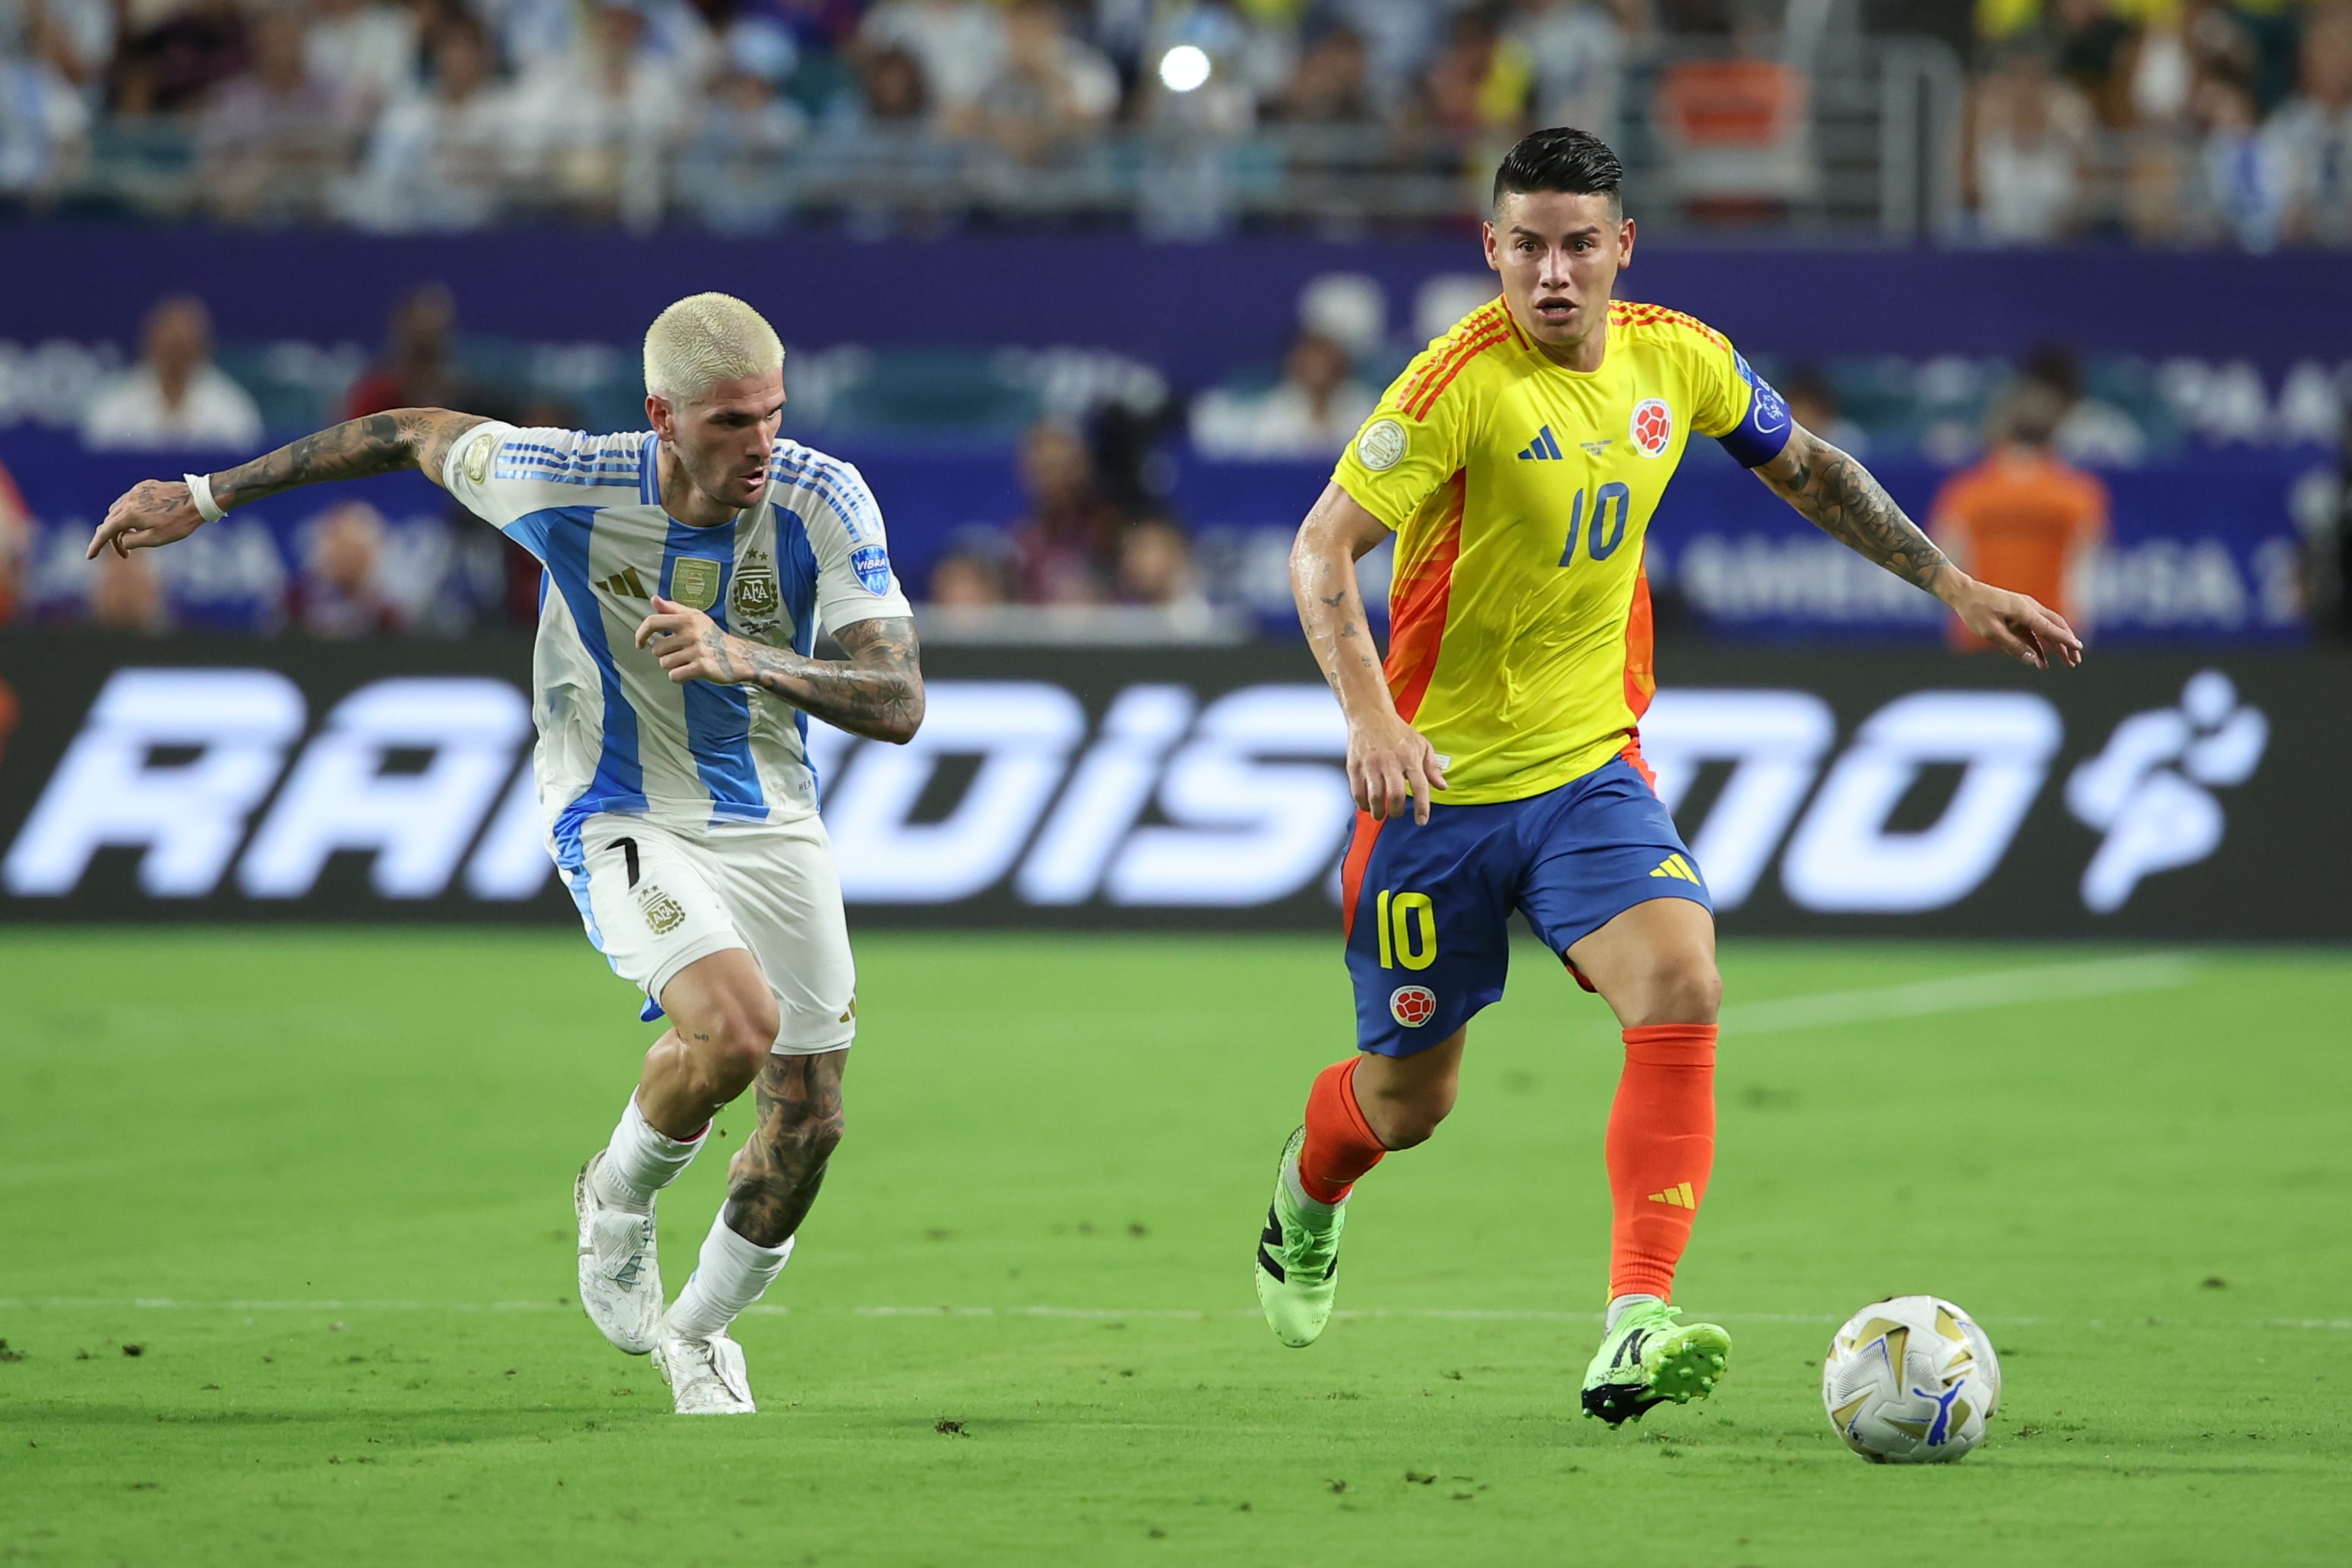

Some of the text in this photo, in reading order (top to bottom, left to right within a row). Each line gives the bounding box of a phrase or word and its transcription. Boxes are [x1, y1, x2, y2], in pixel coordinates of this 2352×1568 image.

[1557, 481, 1630, 567] 10
[741, 579, 769, 603] AFA
[857, 558, 886, 571] VIBRA
[2, 668, 2064, 910] RADISO
[604, 836, 640, 890] 7
[653, 903, 675, 925] AFA
[1377, 889, 1437, 971] 10
